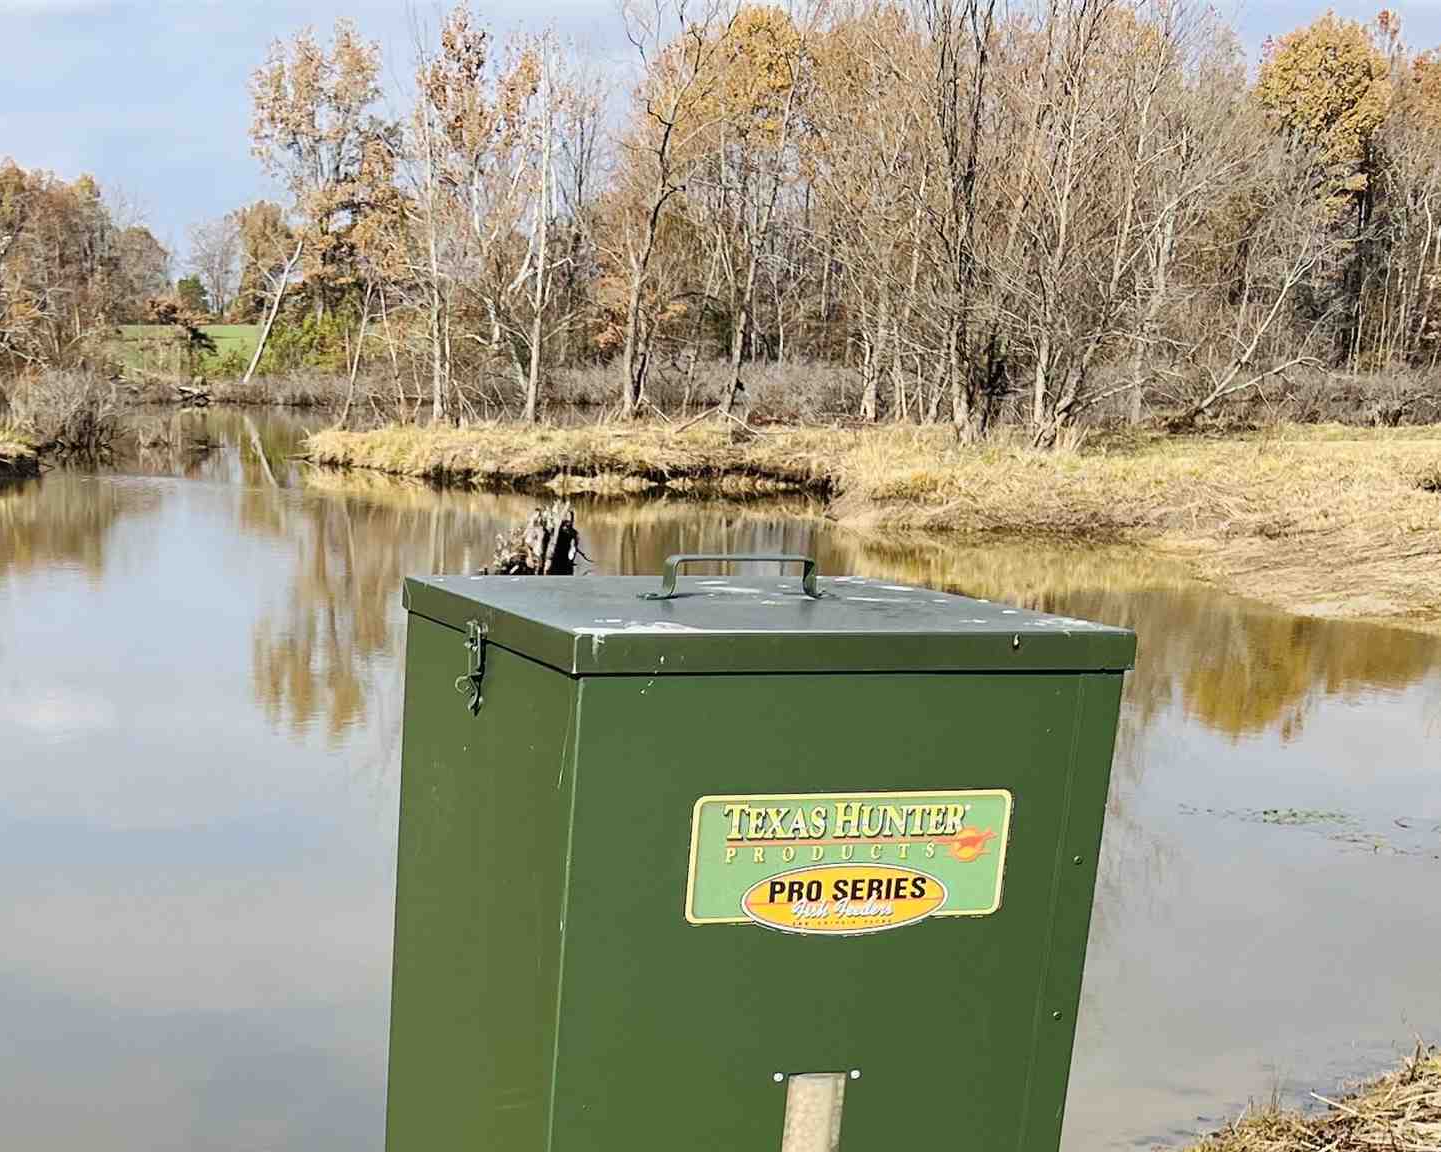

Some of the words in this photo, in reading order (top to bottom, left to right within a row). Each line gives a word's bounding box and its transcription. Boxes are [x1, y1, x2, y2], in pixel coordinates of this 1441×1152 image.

[723, 801, 827, 841] TEXAS
[833, 800, 966, 838] HUNTER
[724, 842, 936, 864] PRODUCTS
[768, 879, 823, 903] PRO
[832, 876, 928, 901] SERIES
